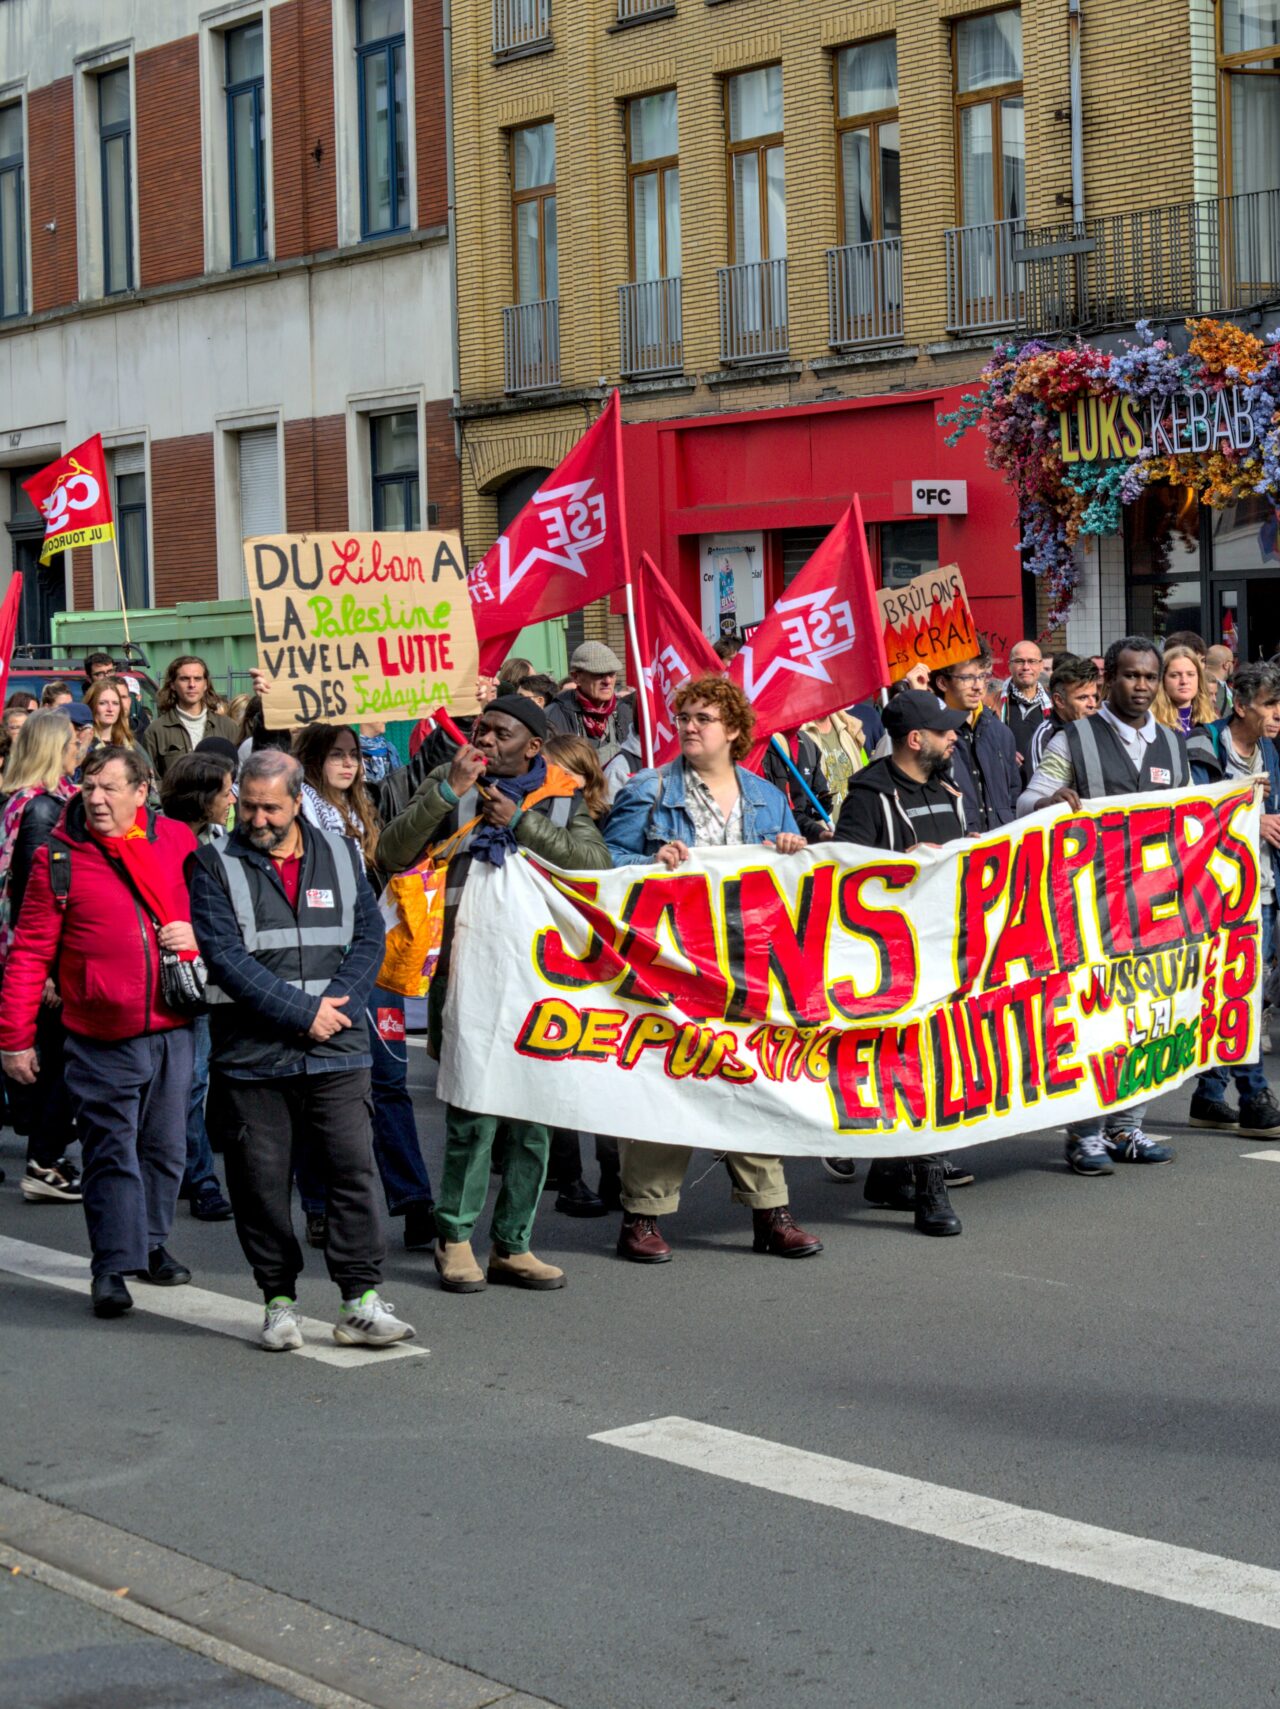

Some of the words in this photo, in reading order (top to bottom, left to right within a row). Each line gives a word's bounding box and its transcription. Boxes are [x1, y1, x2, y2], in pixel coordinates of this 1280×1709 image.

[1150, 384, 1255, 456] KEBAB
[253, 542, 324, 591] DU
[328, 538, 425, 586] Liban
[432, 540, 464, 582] A
[256, 596, 306, 643] LA
[307, 593, 452, 639] Palestine
[883, 575, 961, 625] BRÛLONS
[263, 643, 332, 678] VIVE
[336, 642, 370, 670] LA
[377, 633, 454, 677] LUTTE
[913, 609, 972, 658] CRA!
[292, 680, 348, 724] DES
[351, 674, 453, 717] Fedayin
[1200, 935, 1221, 1064] CSP
[1216, 921, 1259, 1063] 59
[1126, 998, 1173, 1045] LA
[829, 1023, 927, 1131] EN
[930, 972, 1084, 1129] LUTTE
